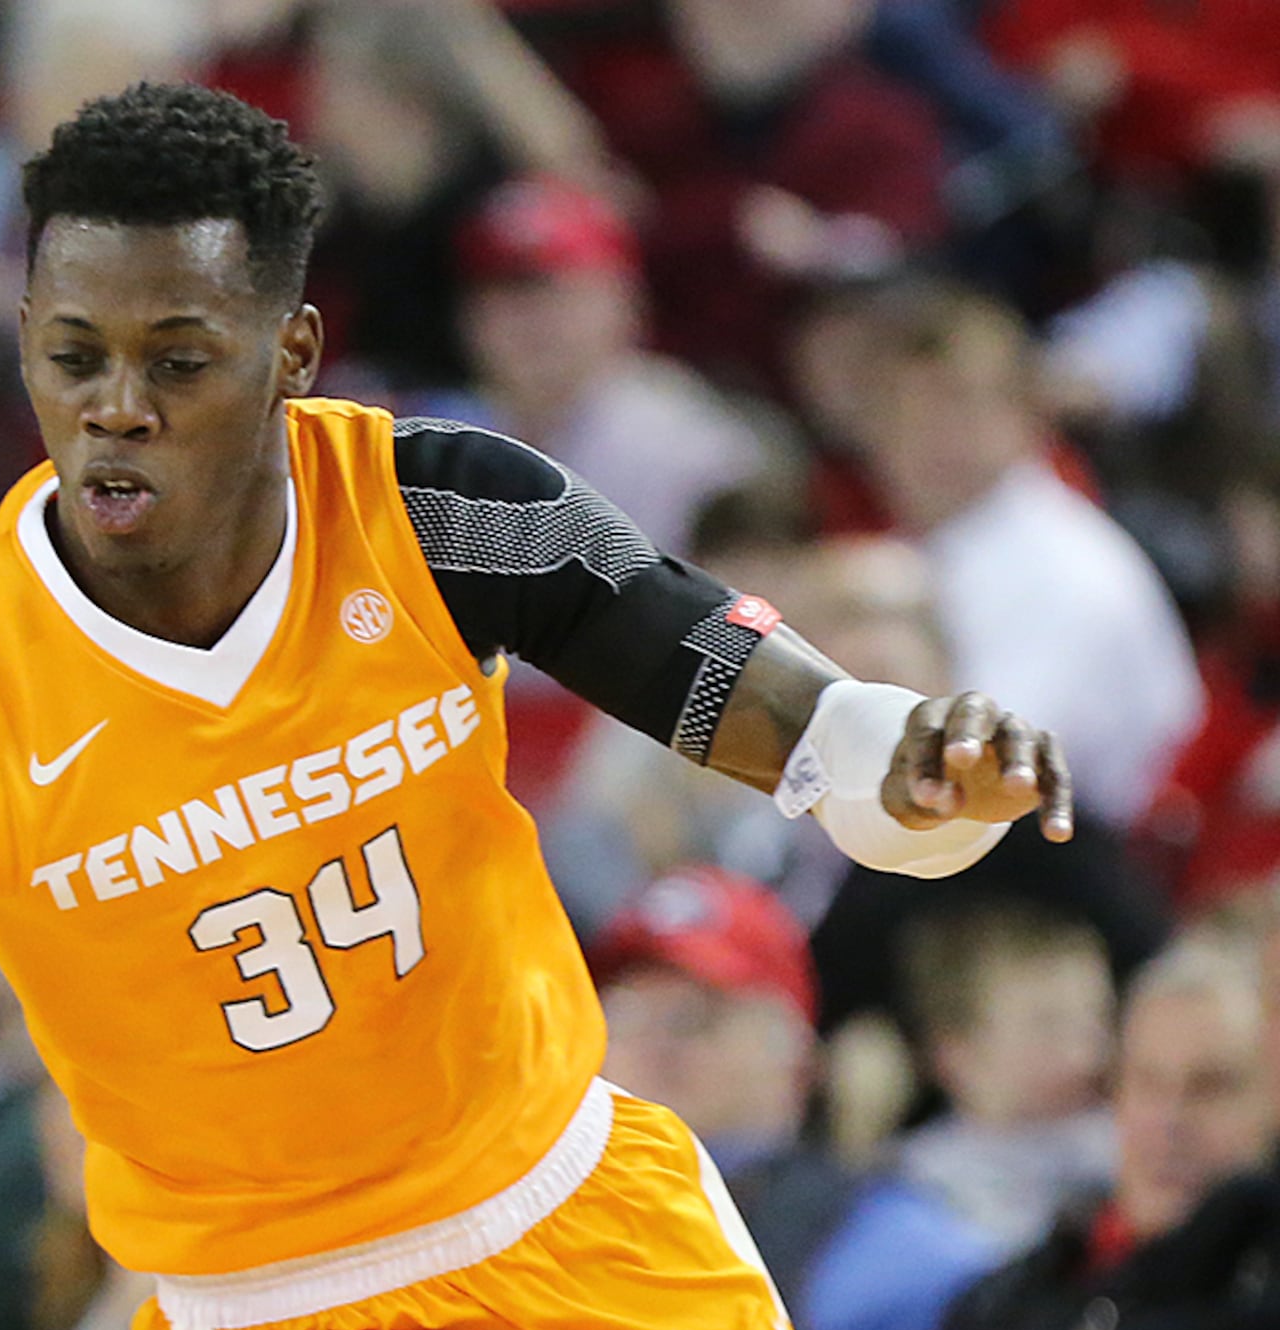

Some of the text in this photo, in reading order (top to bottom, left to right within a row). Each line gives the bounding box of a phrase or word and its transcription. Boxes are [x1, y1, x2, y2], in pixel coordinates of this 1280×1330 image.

[343, 591, 391, 641] SEC
[31, 684, 481, 910] TENNESSEE
[188, 824, 426, 1053] 34
